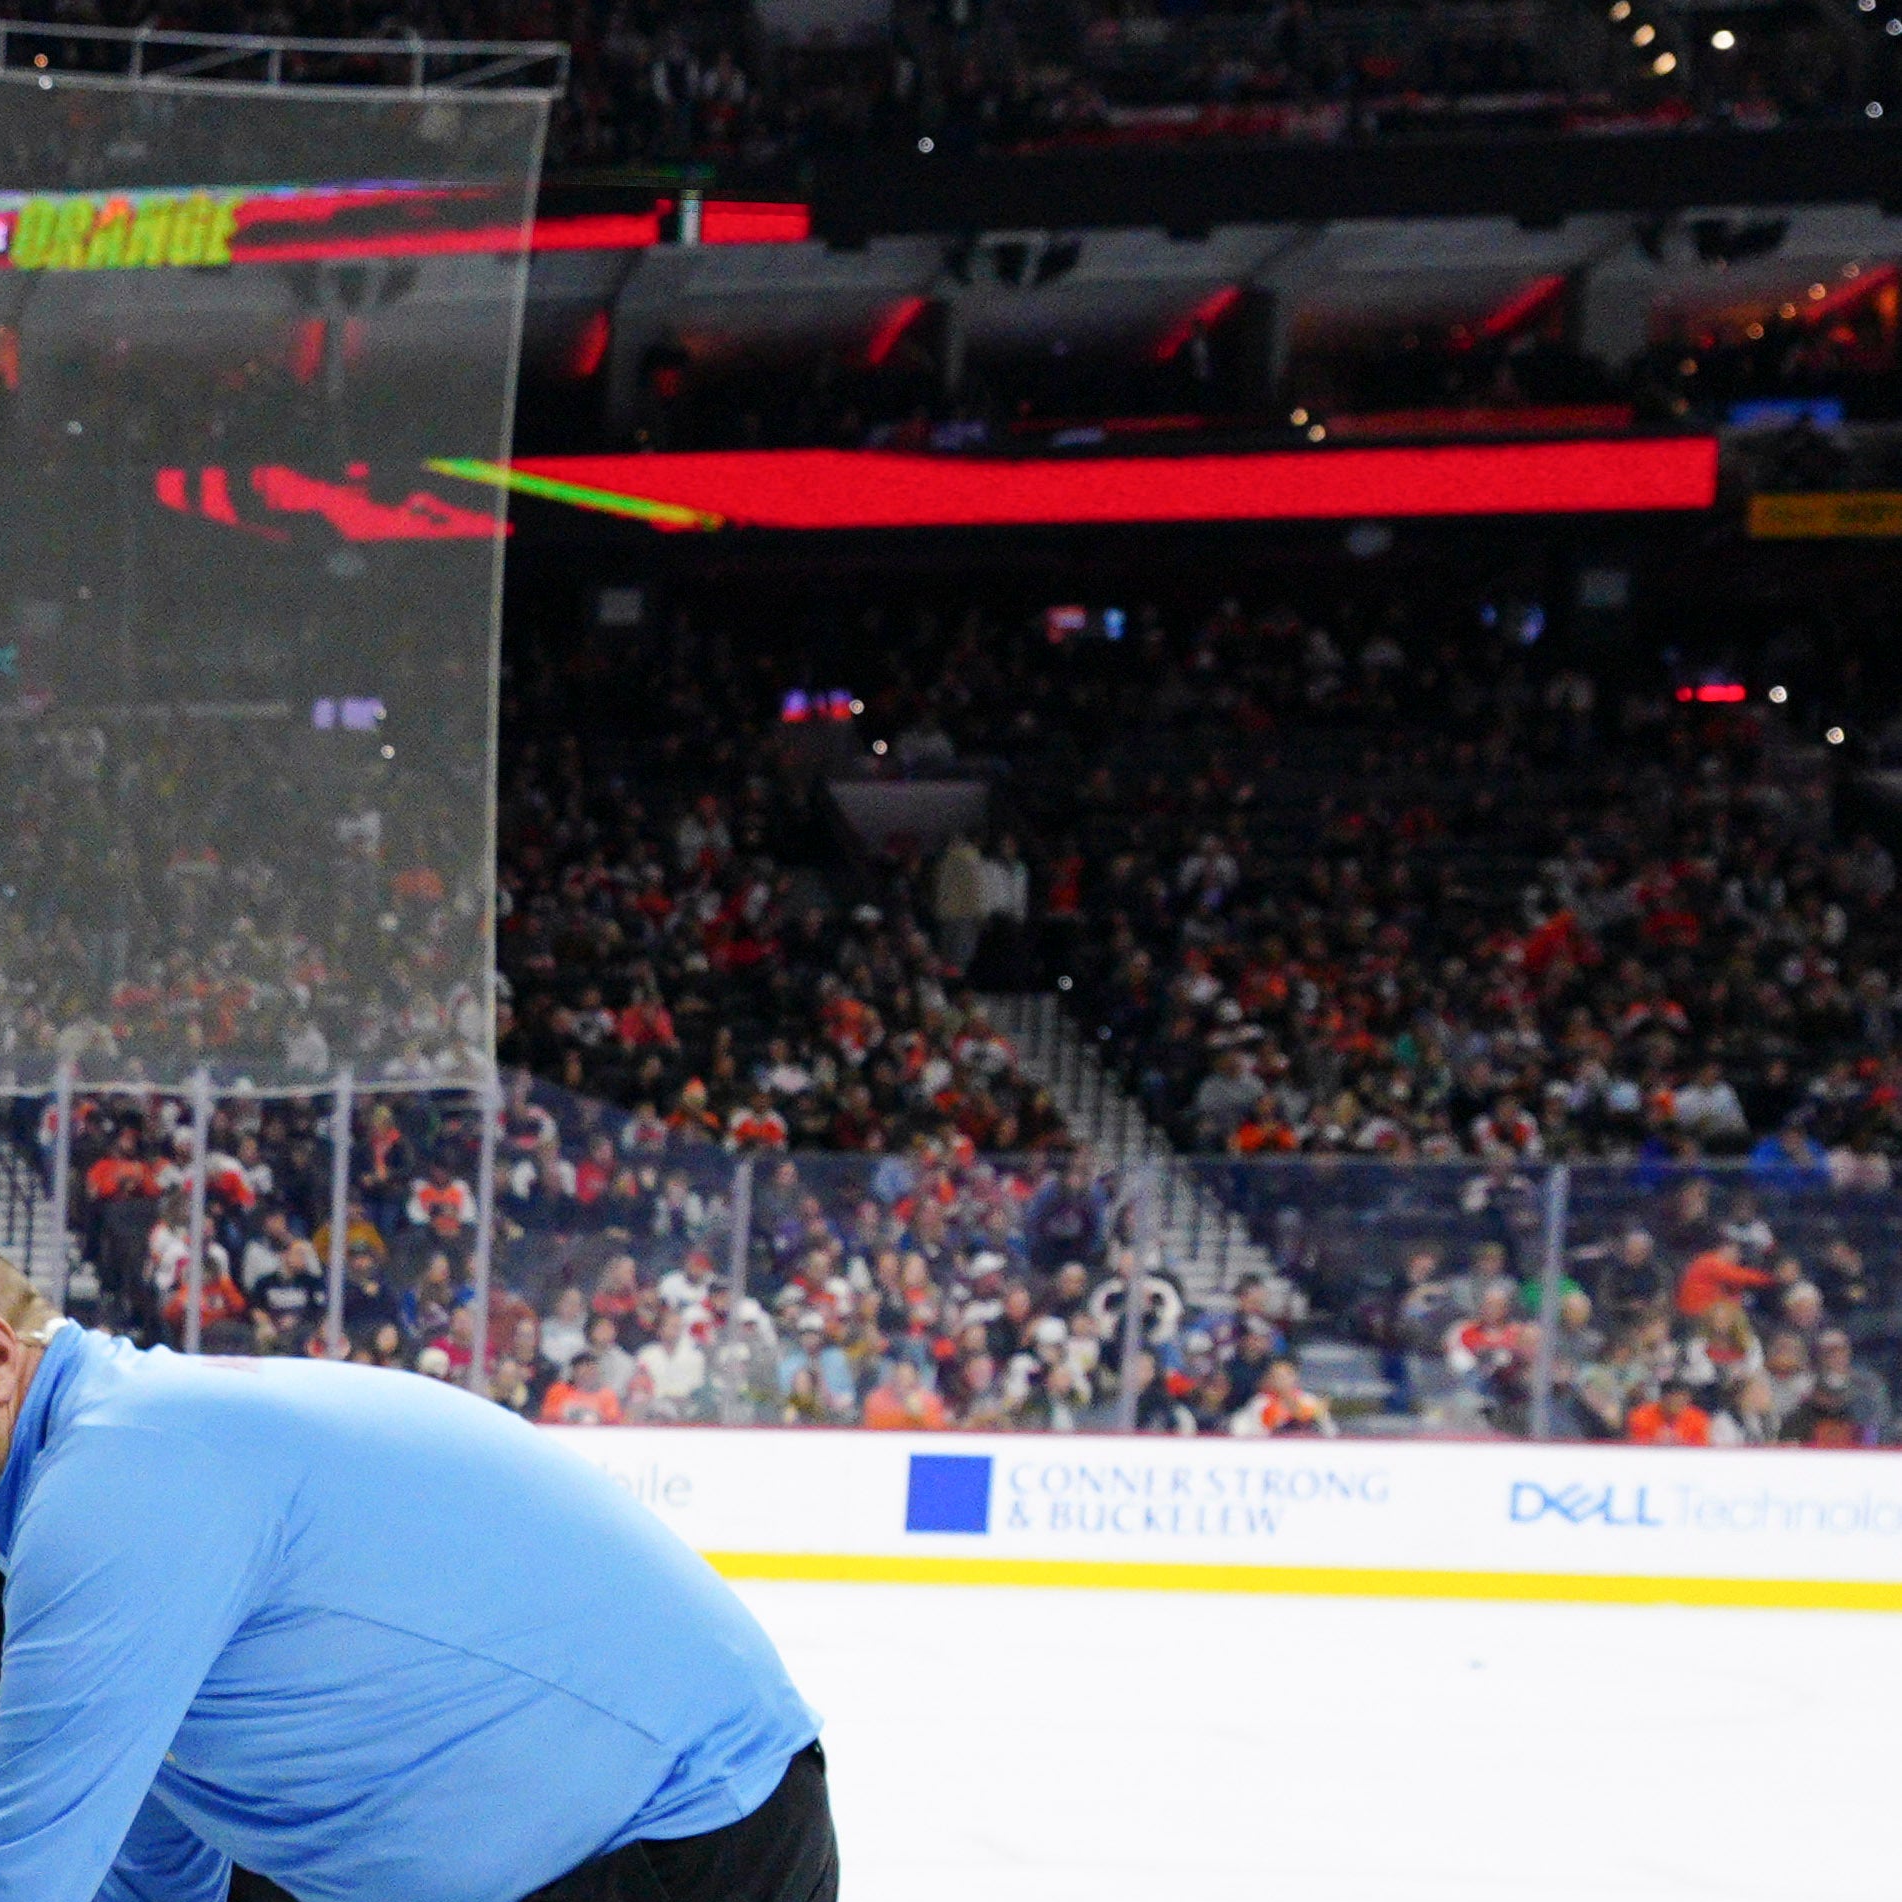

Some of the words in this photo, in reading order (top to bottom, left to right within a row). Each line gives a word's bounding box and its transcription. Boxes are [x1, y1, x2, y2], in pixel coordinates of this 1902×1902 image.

[9, 195, 238, 269] ORANGE
[1204, 1465, 1390, 1504] STRONG
[1509, 1480, 1665, 1528] DELL
[1007, 1501, 1033, 1531] &
[1050, 1501, 1284, 1536] BUCKELEW
